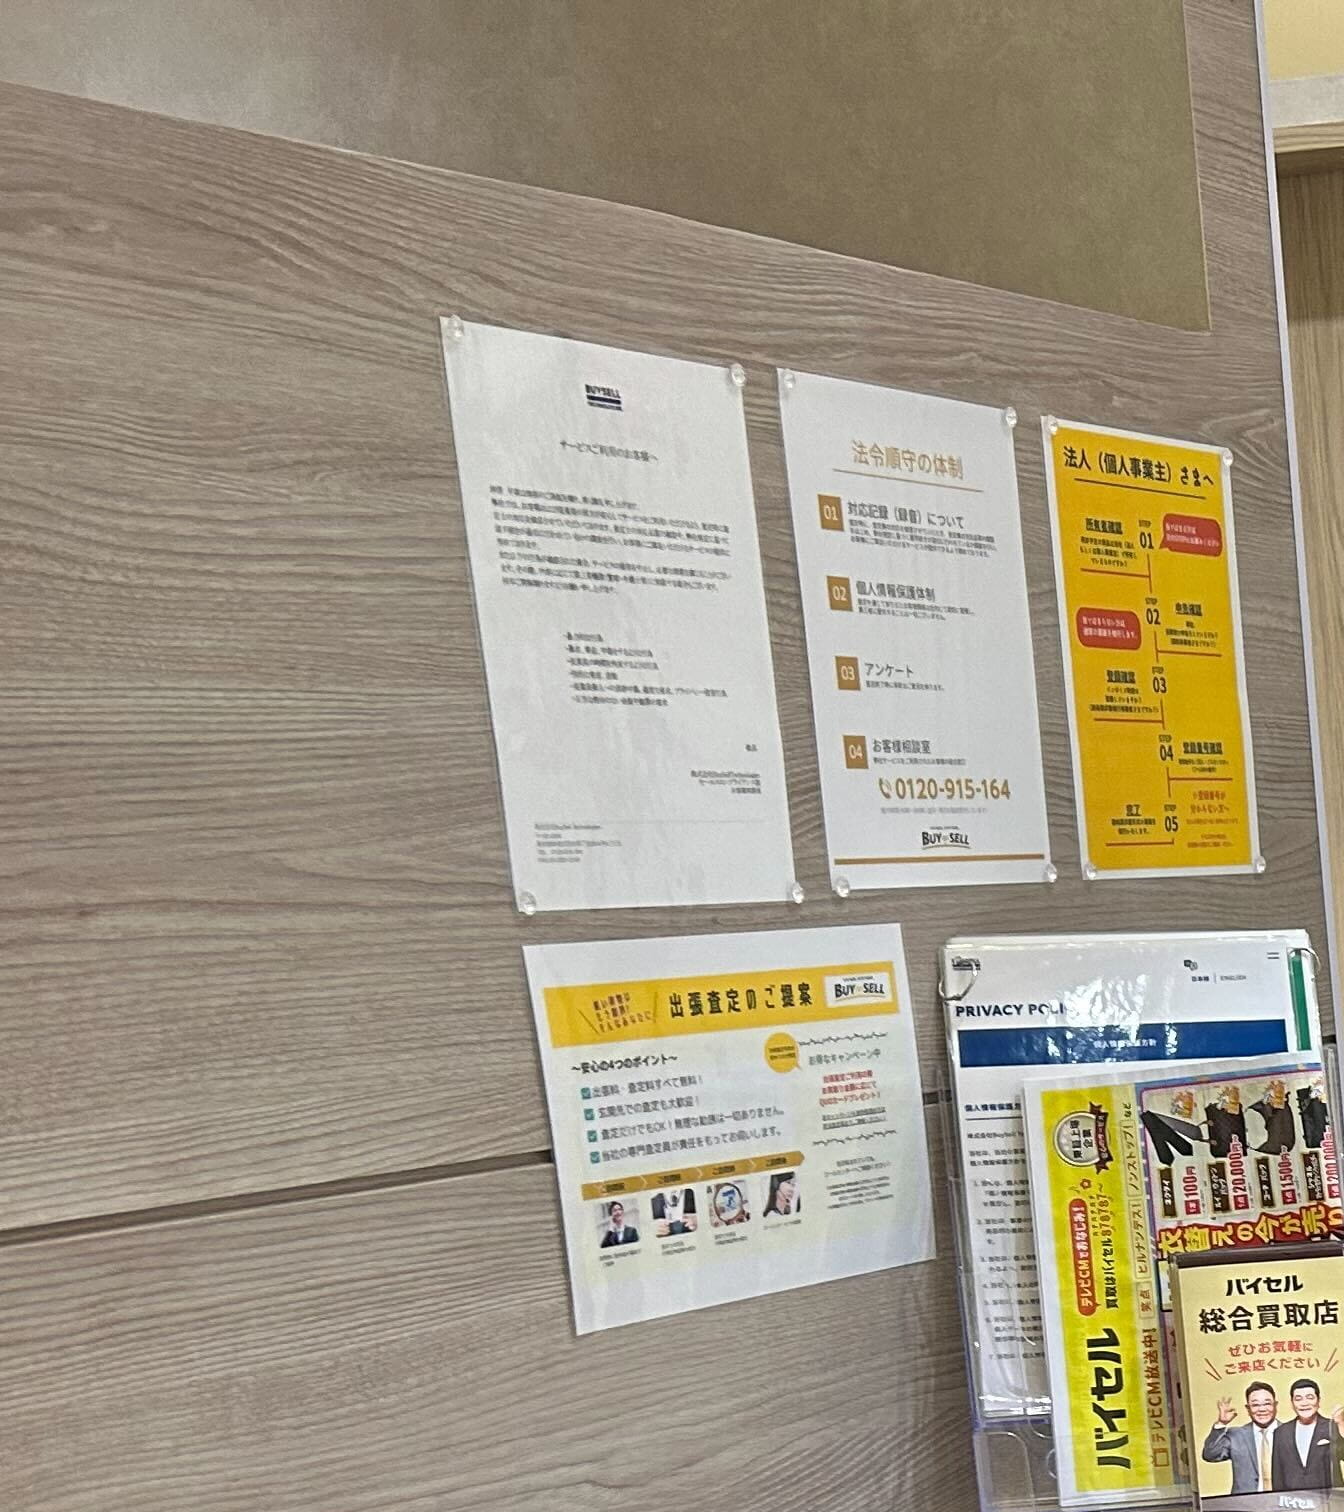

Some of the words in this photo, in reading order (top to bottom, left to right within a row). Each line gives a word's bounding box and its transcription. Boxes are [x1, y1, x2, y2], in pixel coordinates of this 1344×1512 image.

[852, 439, 964, 480] 法令順守の体制
[823, 504, 839, 522] 01
[1139, 530, 1155, 550] 01
[832, 585, 848, 602] 02
[1145, 607, 1161, 625] 02
[840, 665, 856, 682] 03
[864, 662, 915, 679] アンケート
[1152, 676, 1168, 694] 03
[848, 744, 864, 761] 04
[872, 739, 932, 756] お客様相談室
[1159, 745, 1174, 761] 04
[895, 778, 1011, 801] 0120-915-164
[1164, 815, 1179, 833] 05
[921, 831, 942, 846] BUY
[949, 831, 970, 846] SELL
[833, 983, 857, 999] BUY
[862, 980, 886, 996] SELL
[668, 980, 814, 1020] 出張査定のご提案
[955, 1003, 1024, 1018] PRIVACY
[1225, 1274, 1303, 1297] バイセル
[1198, 1299, 1339, 1334] 総合買取店
[1228, 1339, 1314, 1358] ぜひお気軽に
[1224, 1356, 1321, 1376] ご来店ください
[1086, 1327, 1132, 1470] バイセル
